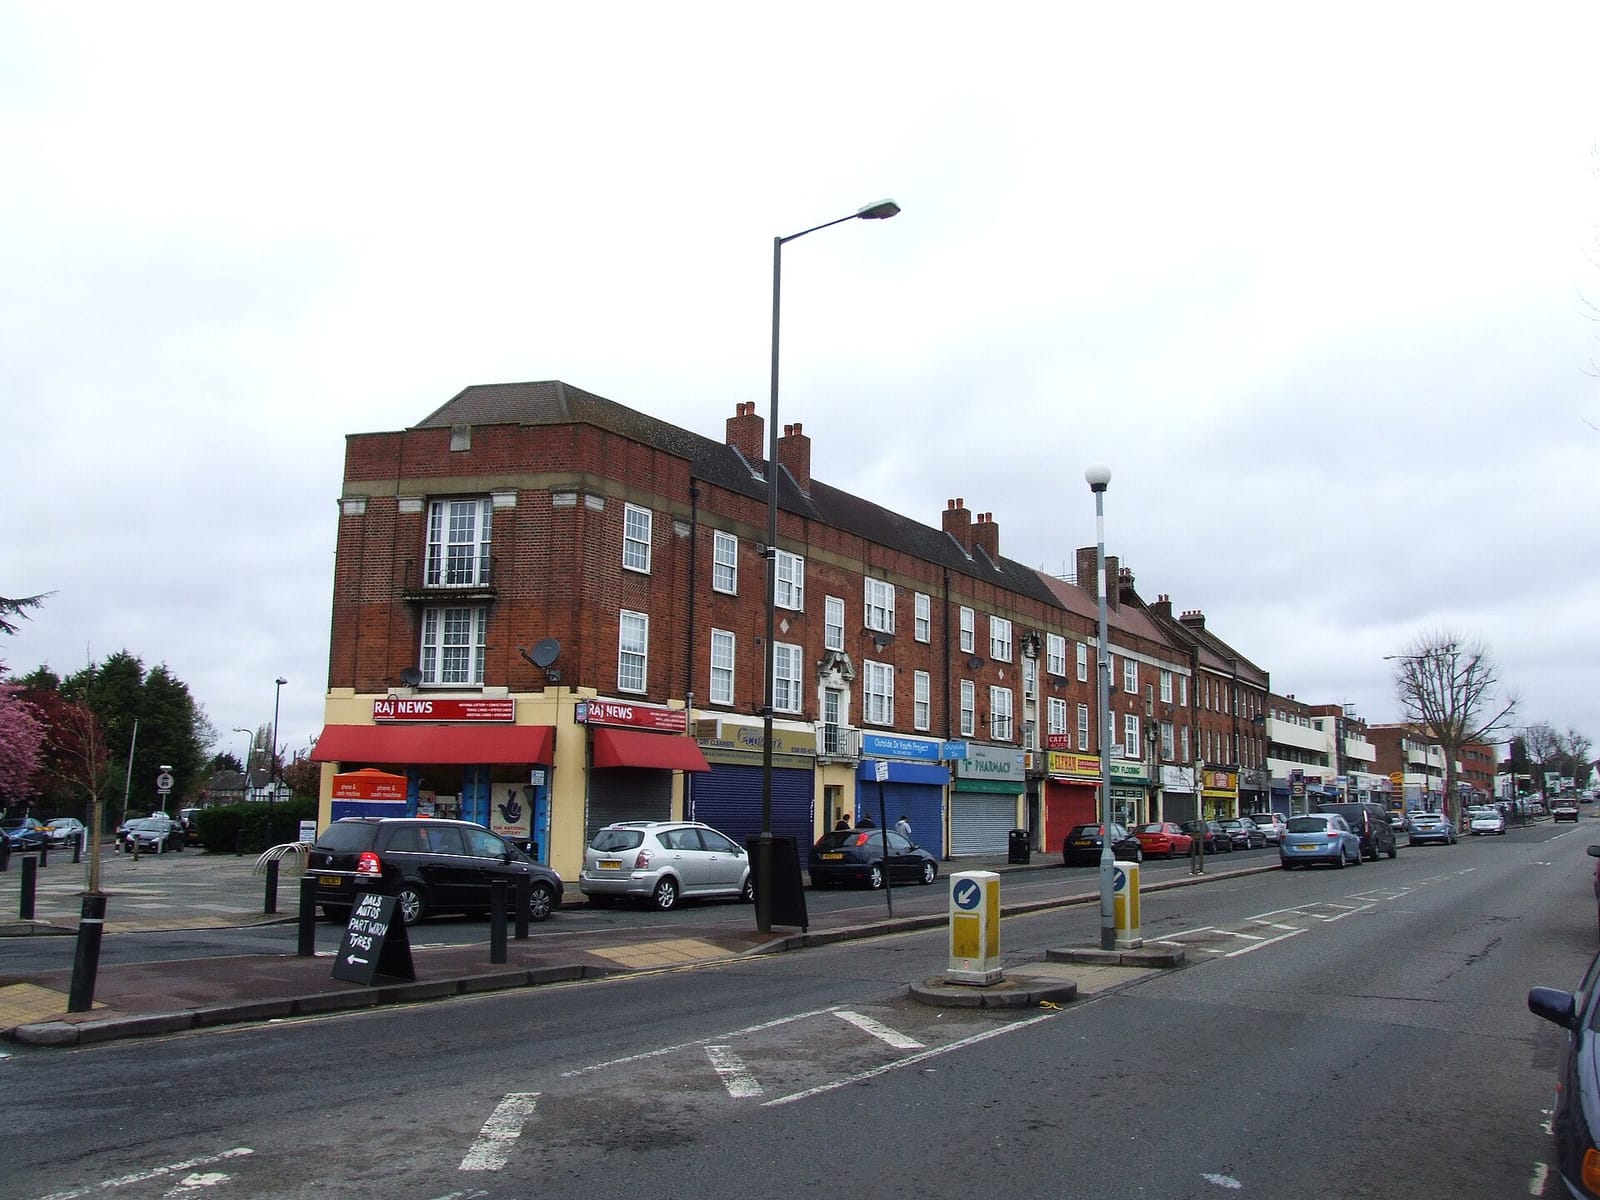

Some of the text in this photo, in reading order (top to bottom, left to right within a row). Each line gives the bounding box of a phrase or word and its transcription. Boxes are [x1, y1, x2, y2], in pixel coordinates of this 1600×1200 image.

[397, 701, 433, 714] NEWS
[606, 705, 633, 719] NEWS
[874, 738, 893, 748] Outside
[893, 740, 899, 749] In
[899, 741, 912, 750] Youth
[912, 742, 929, 753] Project
[975, 759, 1011, 774] PHARMACY
[348, 918, 389, 936] PART WORN
